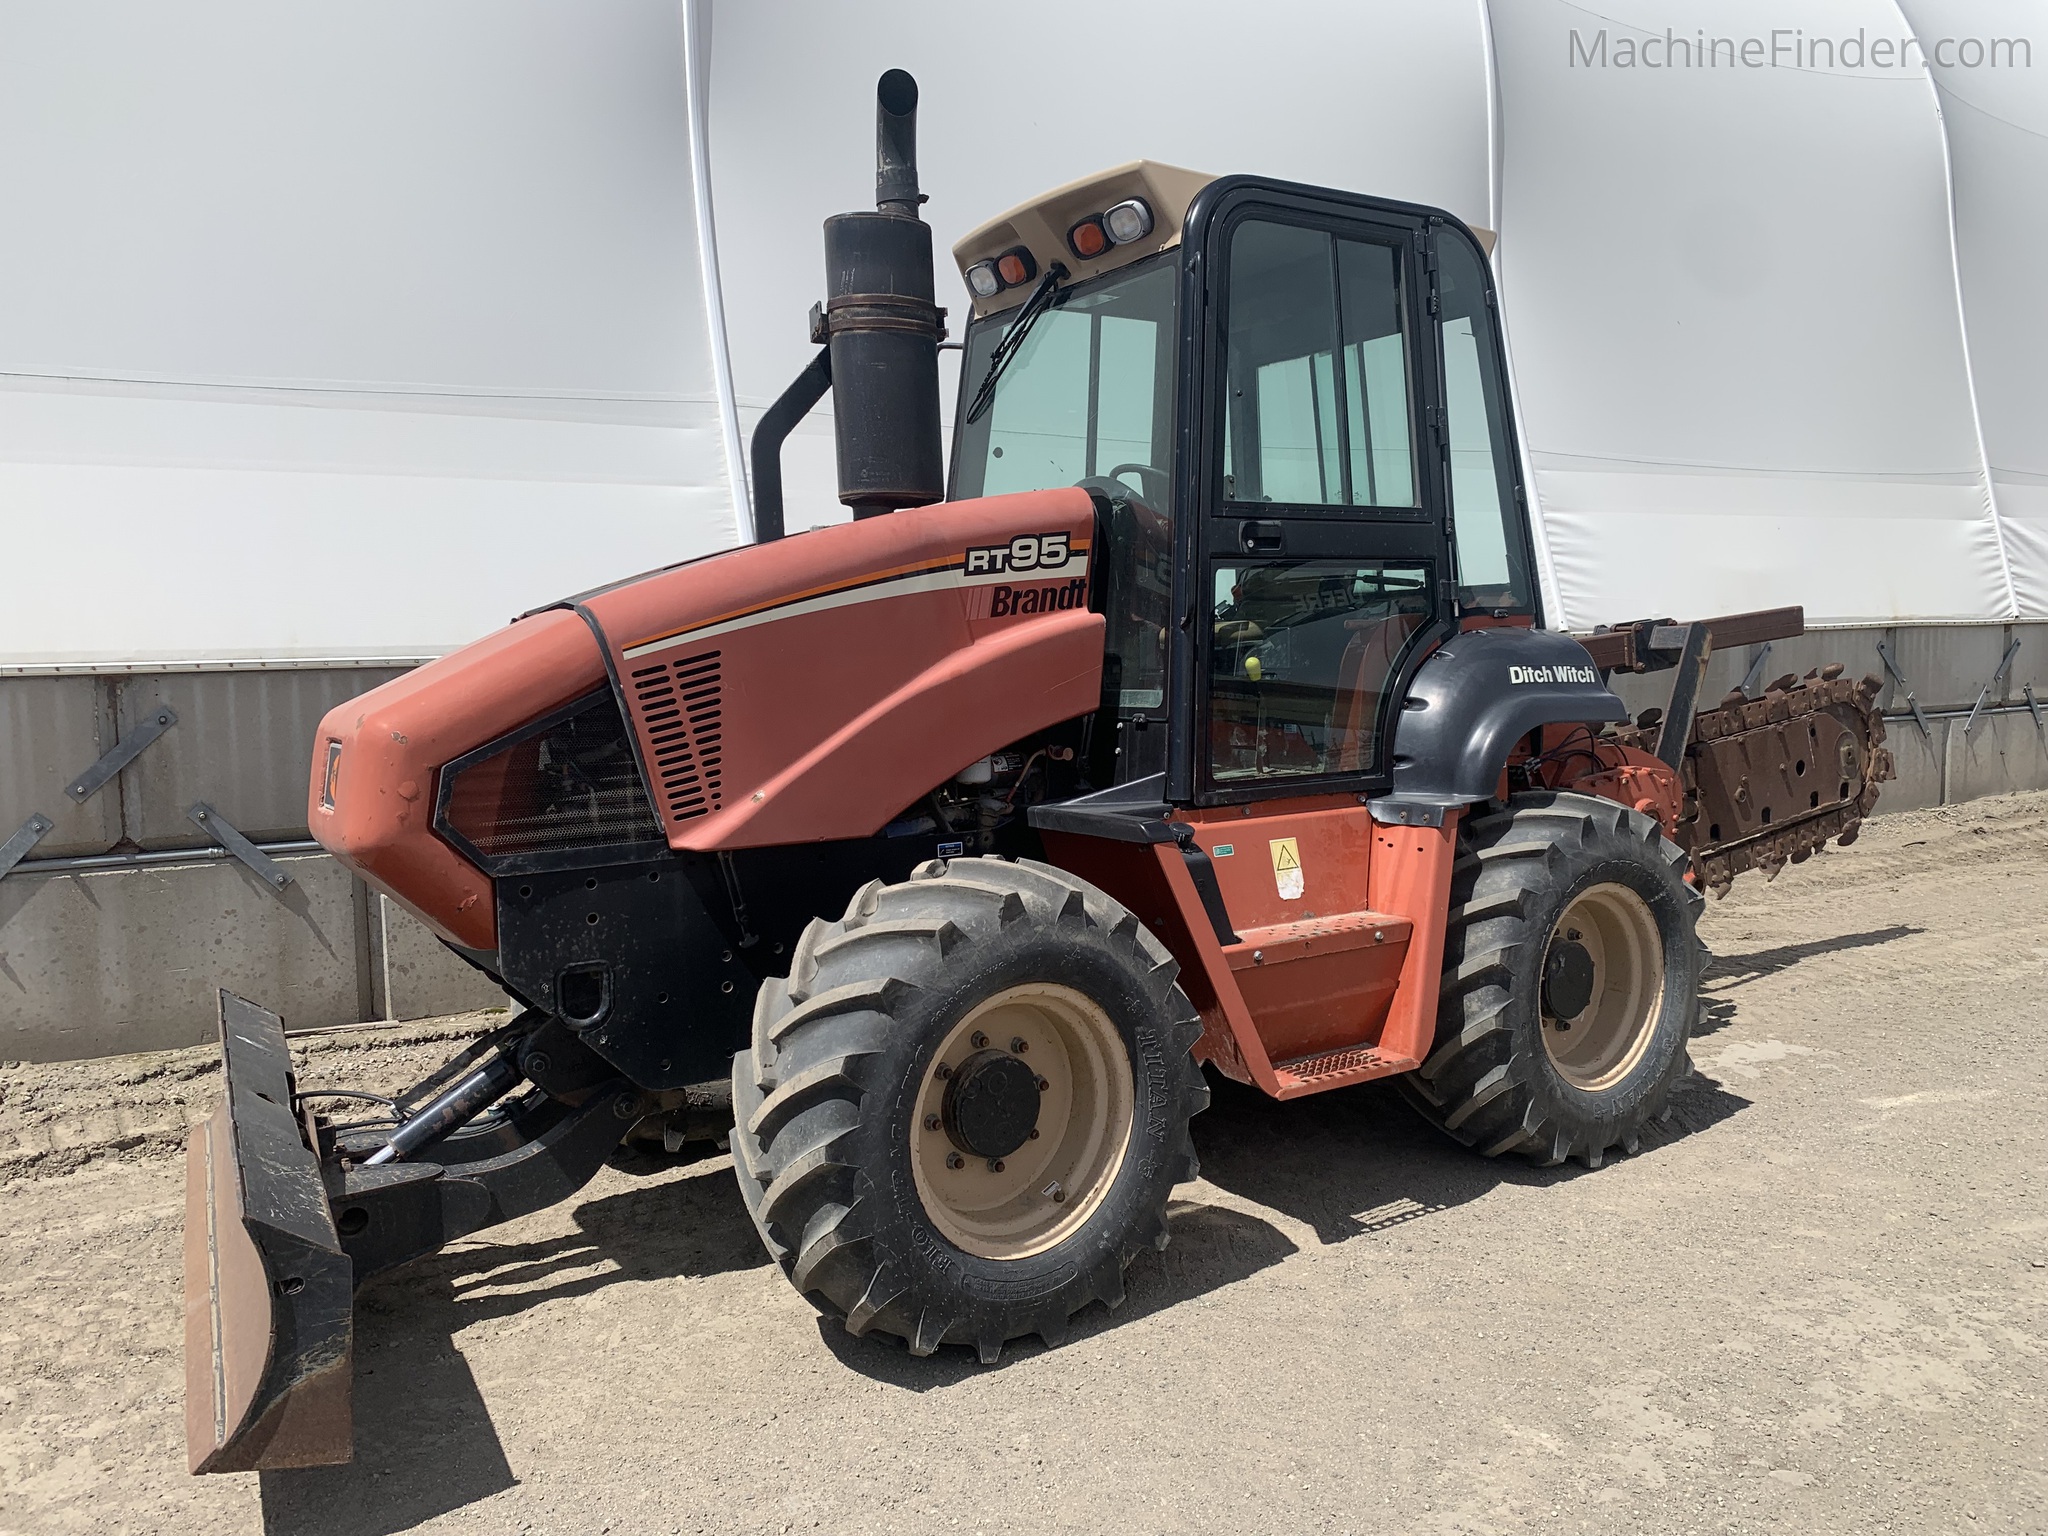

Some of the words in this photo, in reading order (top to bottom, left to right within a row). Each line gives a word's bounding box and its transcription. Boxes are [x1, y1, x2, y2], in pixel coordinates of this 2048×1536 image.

[967, 534, 1069, 573] RT95
[989, 578, 1087, 618] Brandt
[1508, 665, 1553, 684] Ditch
[1552, 665, 1595, 683] Witch
